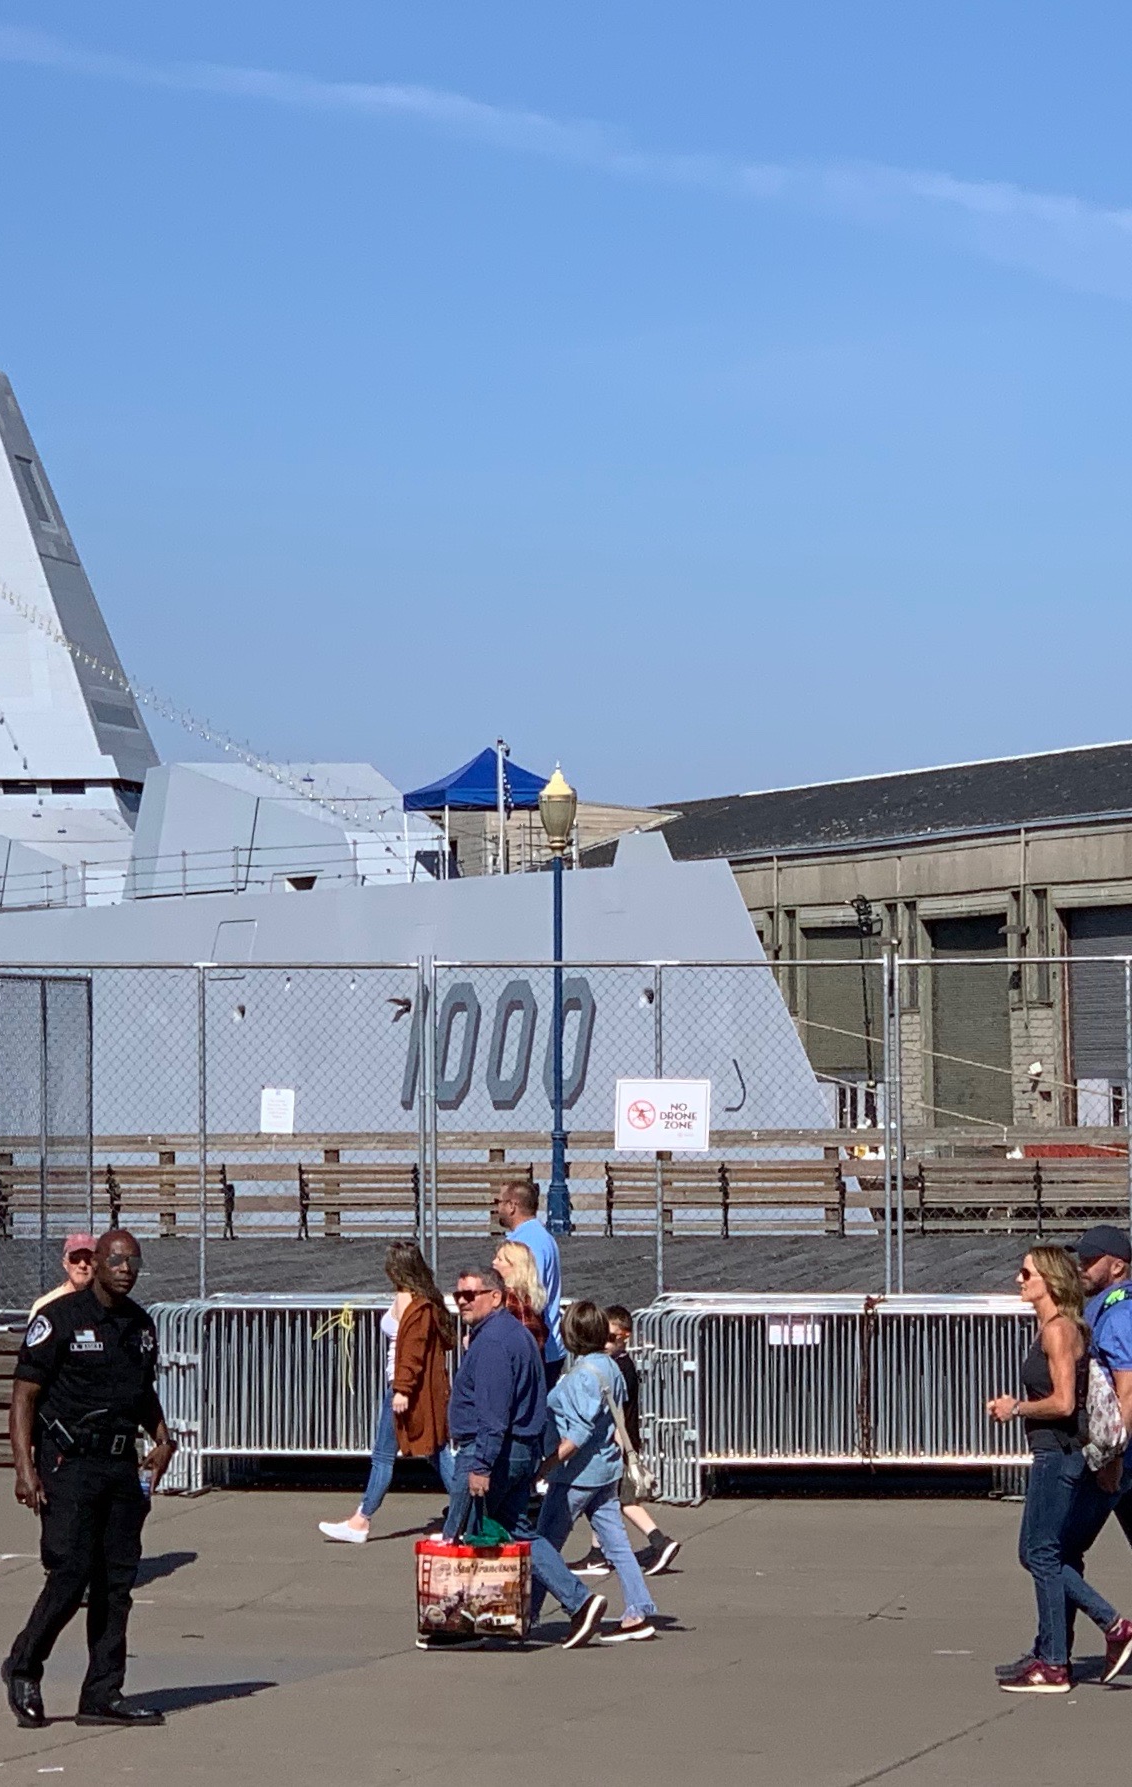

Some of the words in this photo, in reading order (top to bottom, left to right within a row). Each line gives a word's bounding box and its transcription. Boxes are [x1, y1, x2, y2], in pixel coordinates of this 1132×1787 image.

[401, 977, 596, 1110] 1000
[670, 1103, 688, 1111] NO
[660, 1112, 697, 1120] DRONE
[664, 1121, 693, 1129] ZONE
